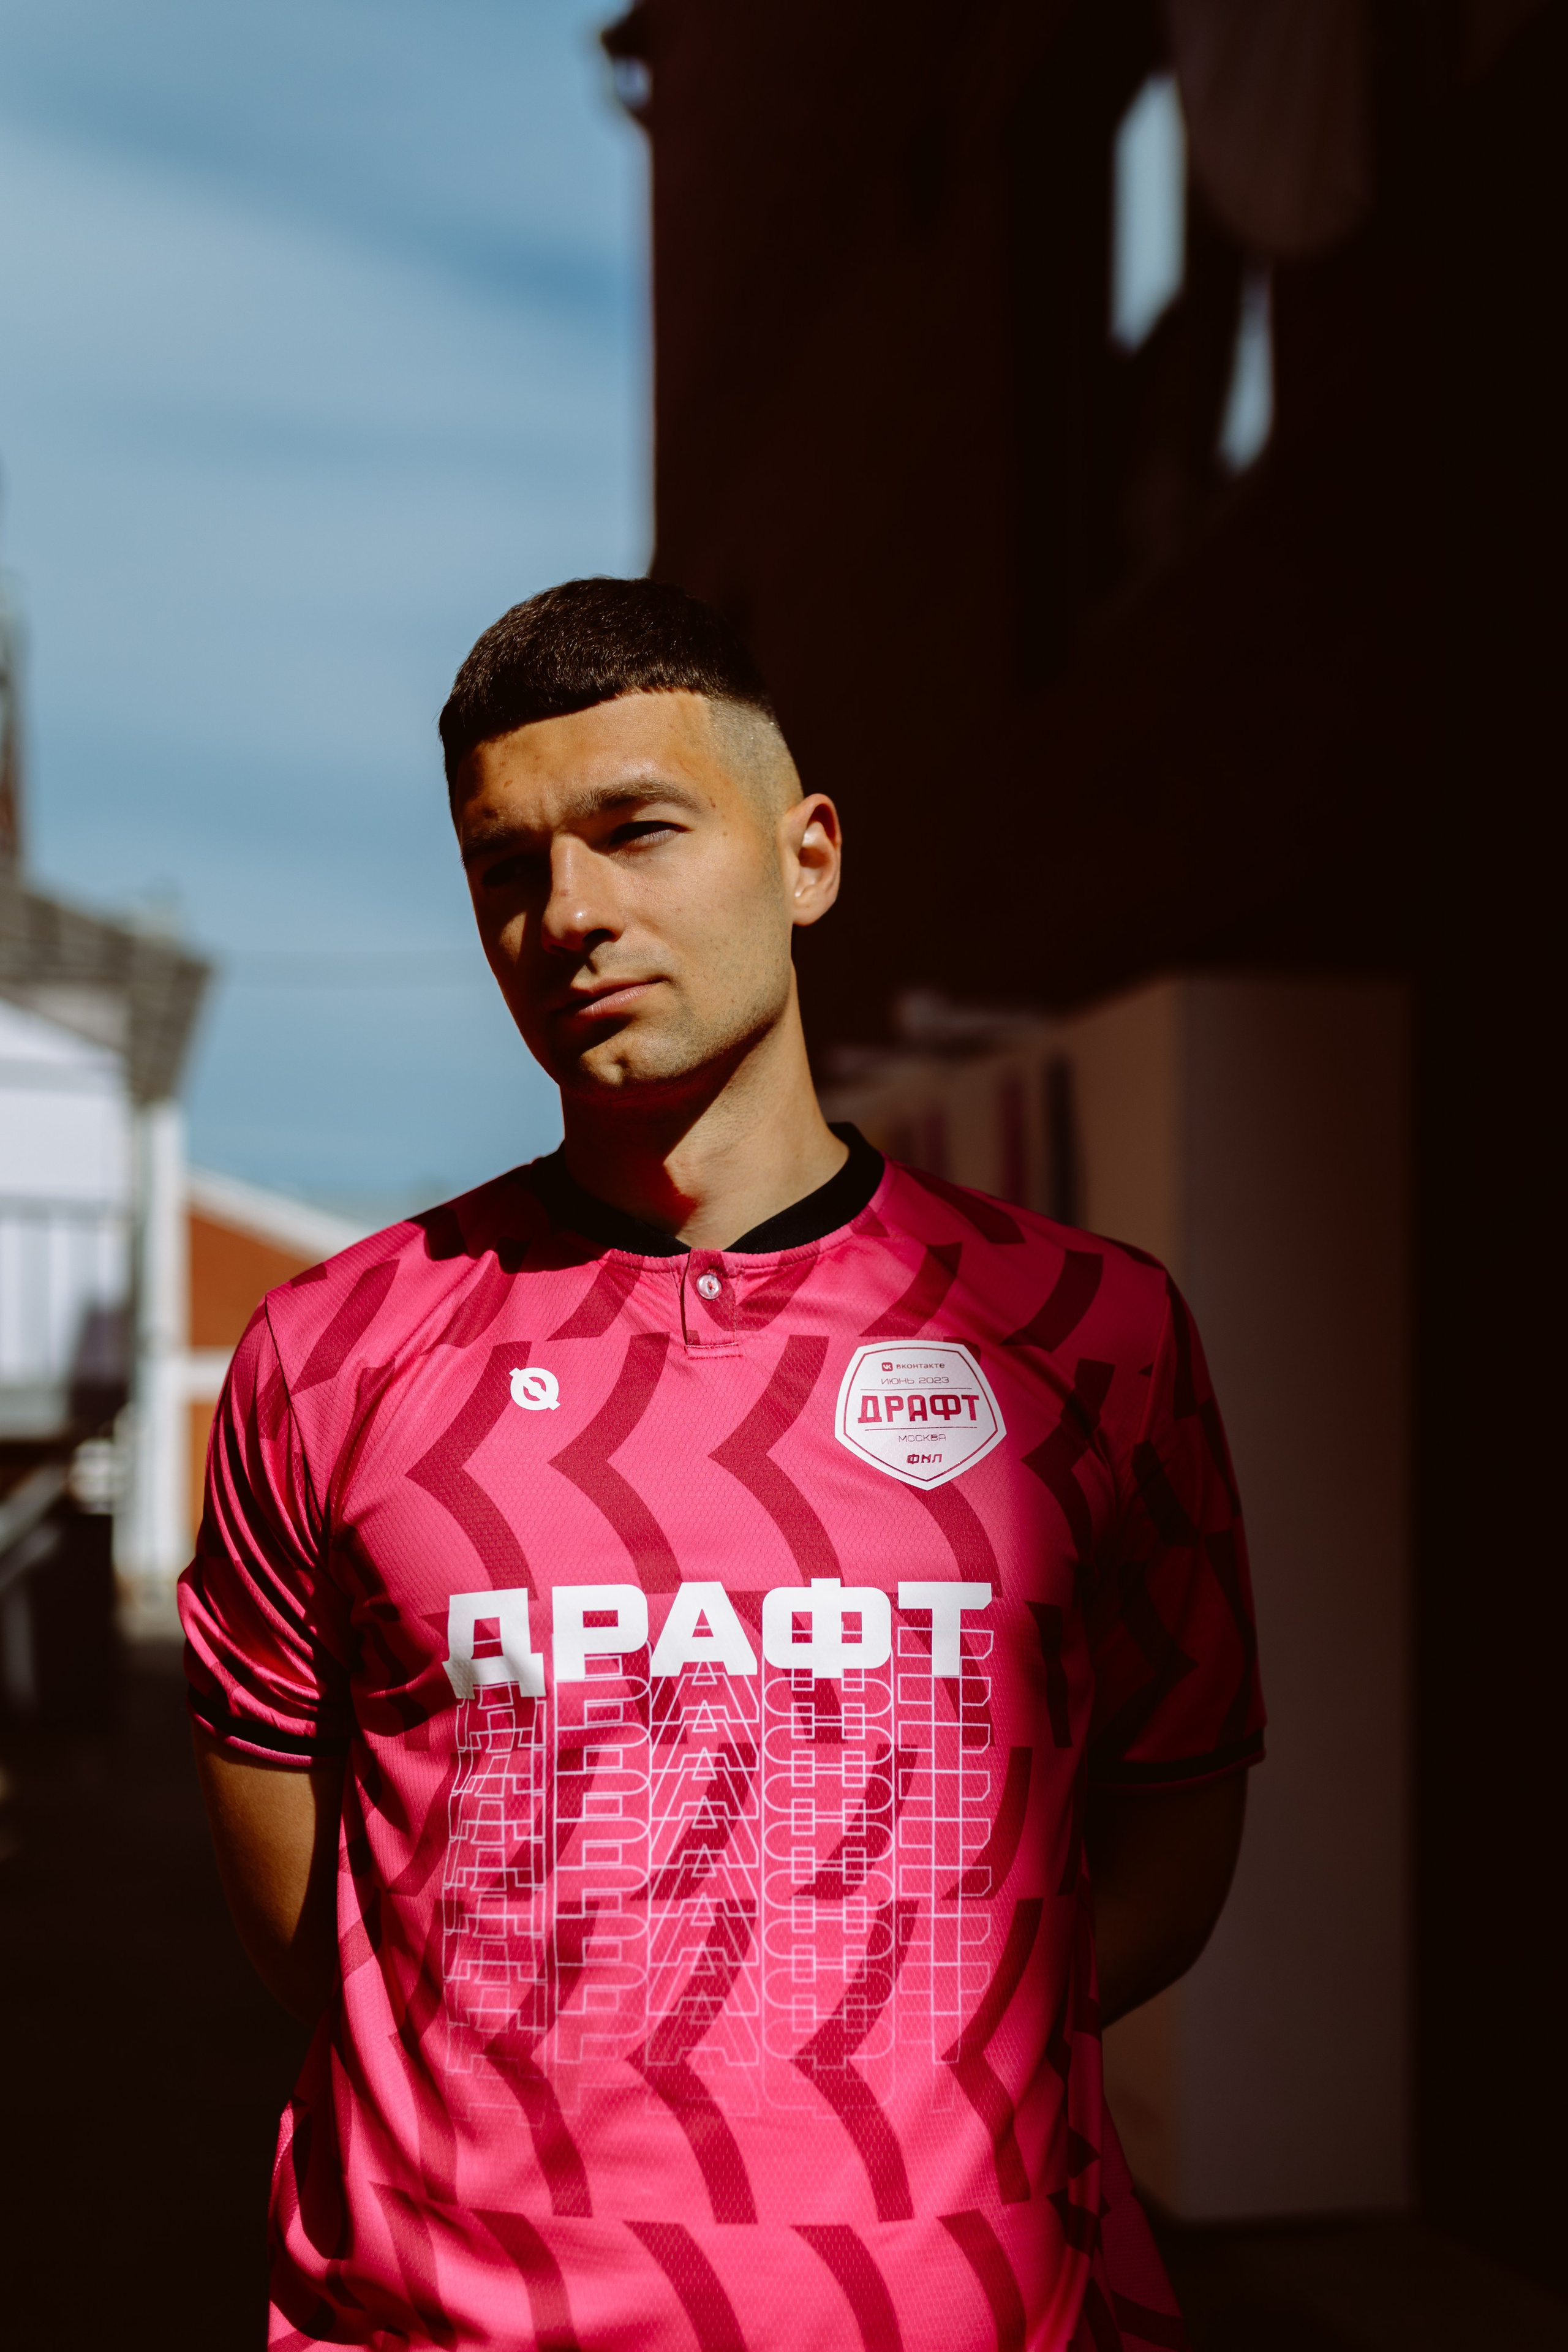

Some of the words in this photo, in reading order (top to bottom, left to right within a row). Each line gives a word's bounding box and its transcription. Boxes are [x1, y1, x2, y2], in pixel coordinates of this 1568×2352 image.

[858, 1394, 979, 1423] ДРАФТ
[899, 1433, 946, 1442] МОСКВА
[442, 1578, 992, 1700] ДРАФТ
